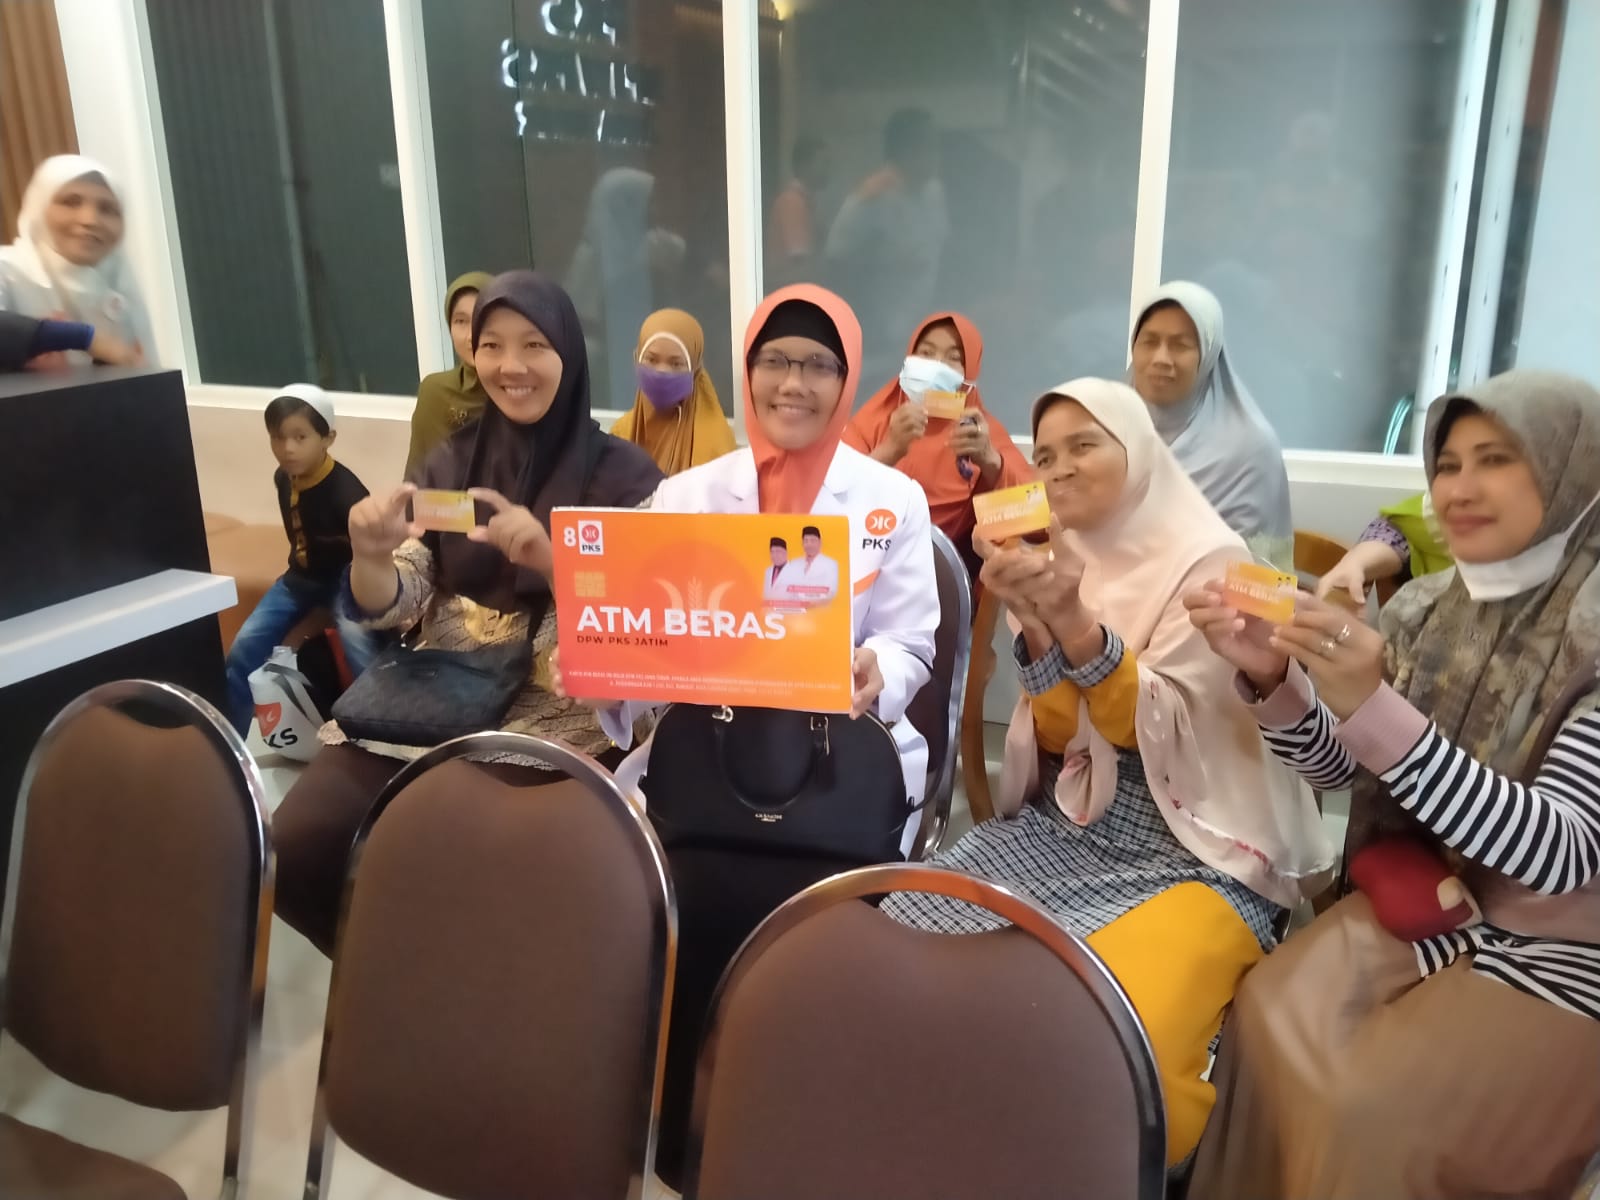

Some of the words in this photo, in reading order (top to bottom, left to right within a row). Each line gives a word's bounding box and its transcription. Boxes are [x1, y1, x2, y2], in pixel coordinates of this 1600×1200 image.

[563, 526, 577, 547] 8
[582, 544, 602, 552] PKS
[862, 538, 892, 551] PKS
[576, 605, 652, 634] ATM
[664, 608, 786, 640] BERAS
[576, 635, 604, 645] DPW
[608, 636, 631, 646] PKS
[634, 638, 669, 647] JATIM
